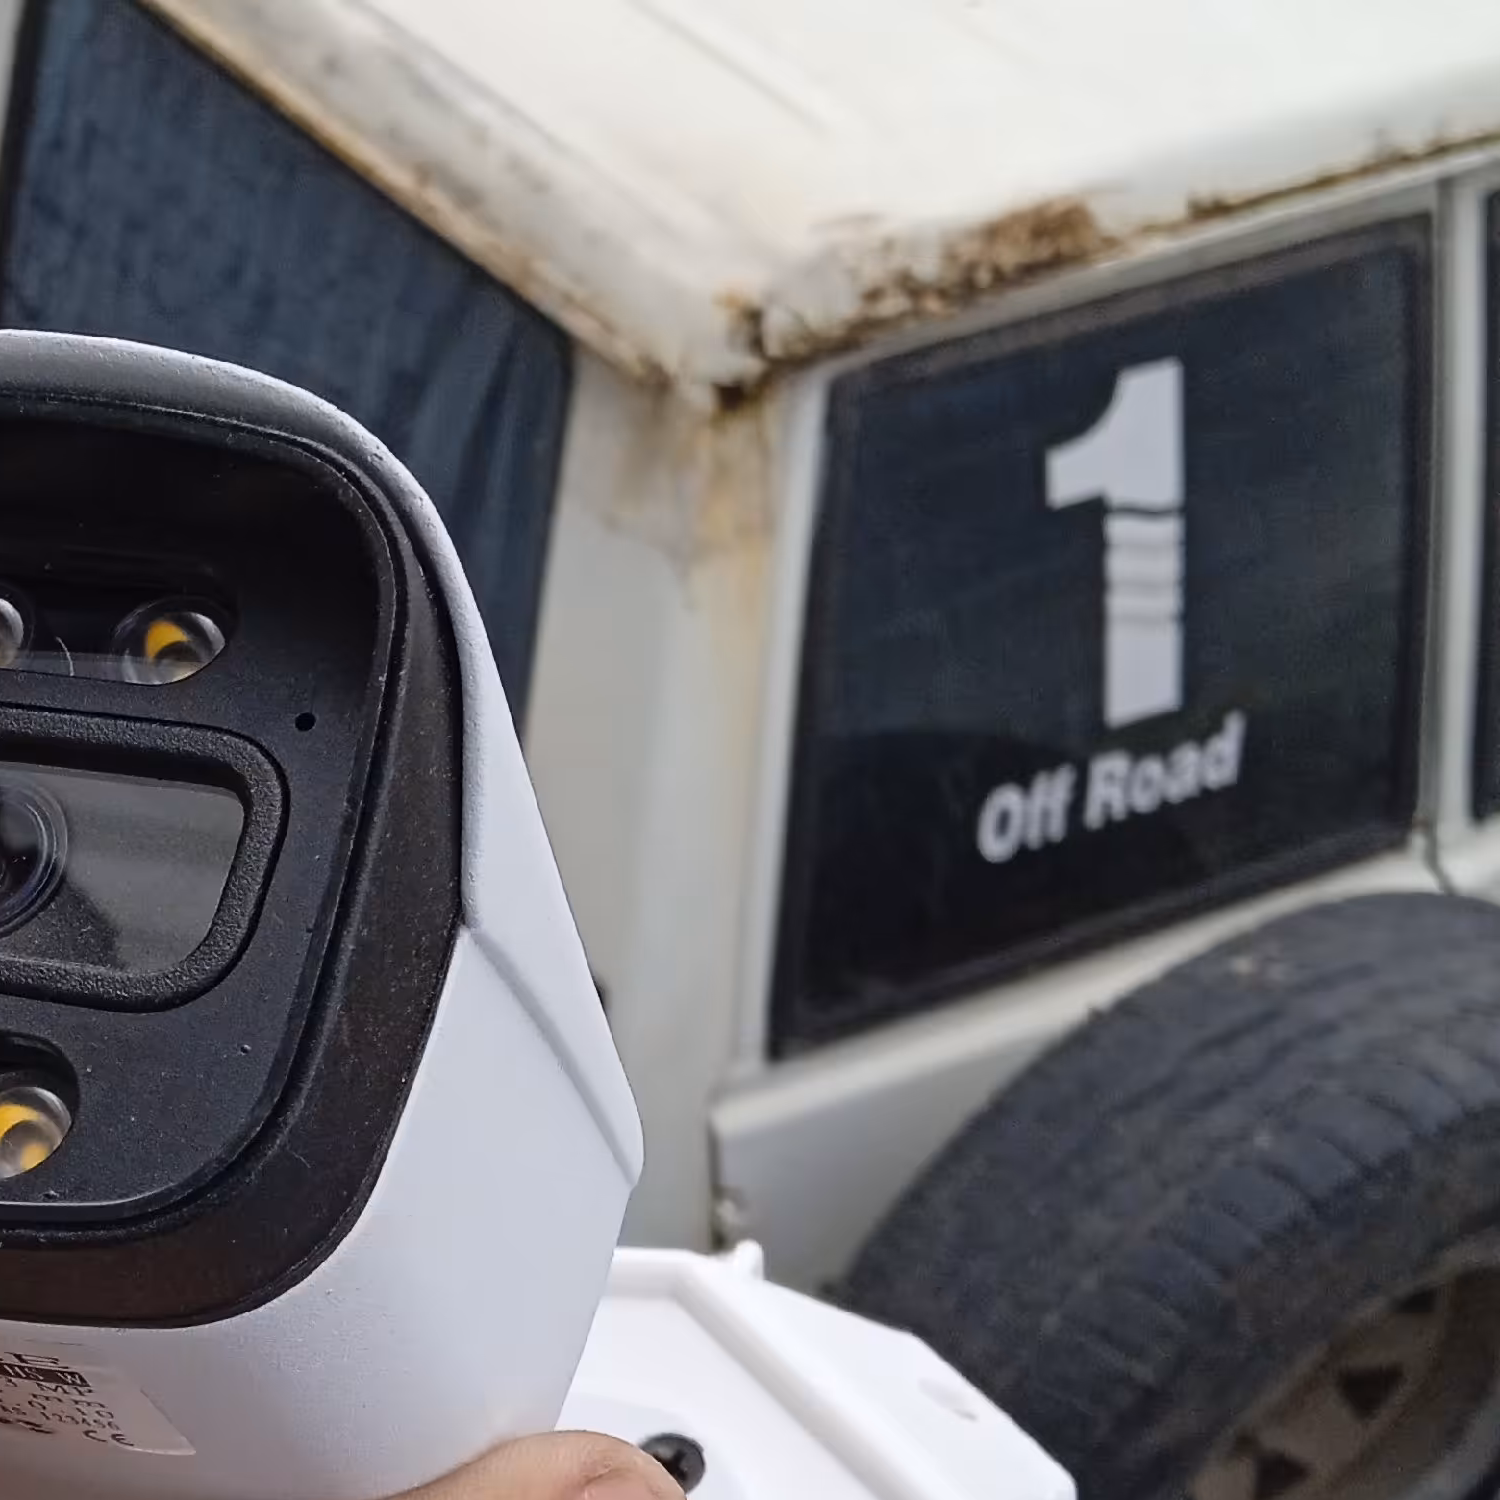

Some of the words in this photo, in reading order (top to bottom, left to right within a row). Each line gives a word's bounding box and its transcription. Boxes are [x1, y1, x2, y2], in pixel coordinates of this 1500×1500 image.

[1044, 356, 1185, 728] 1
[977, 762, 1075, 863] Off
[1084, 708, 1246, 830] Road
